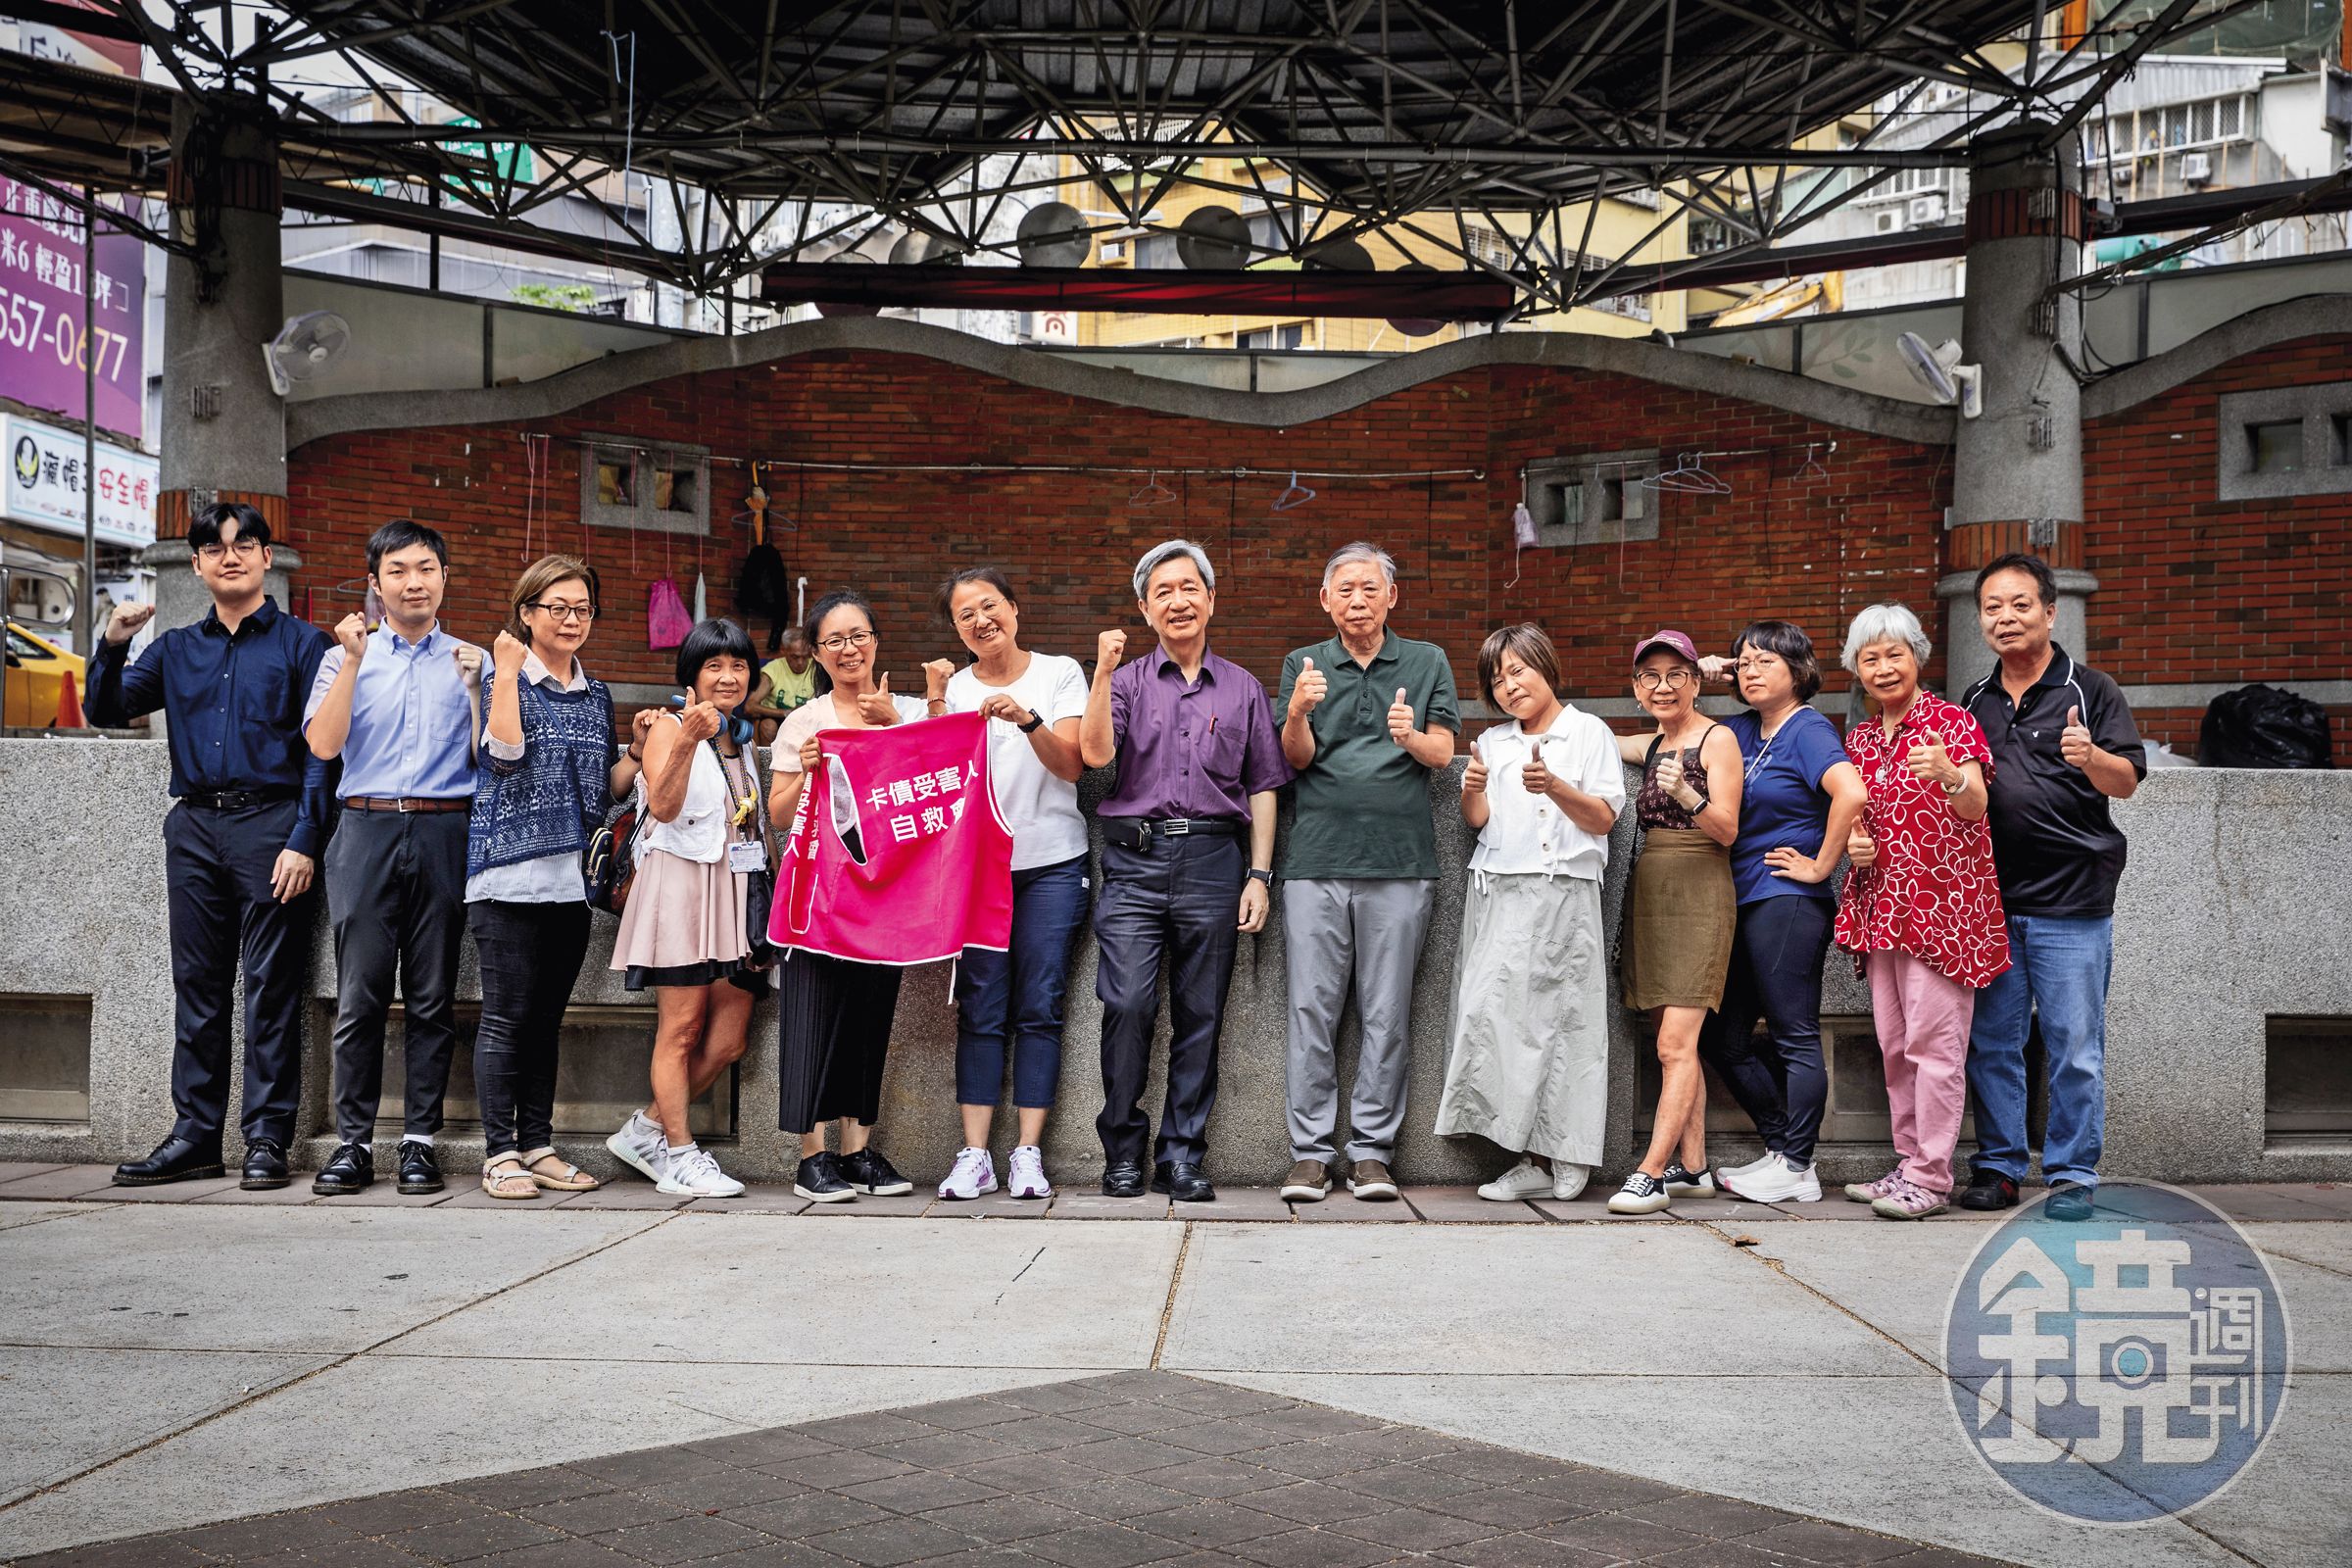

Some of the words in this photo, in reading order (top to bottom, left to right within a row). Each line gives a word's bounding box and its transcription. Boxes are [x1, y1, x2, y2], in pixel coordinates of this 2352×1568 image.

[865, 760, 979, 811] 卡債受害人
